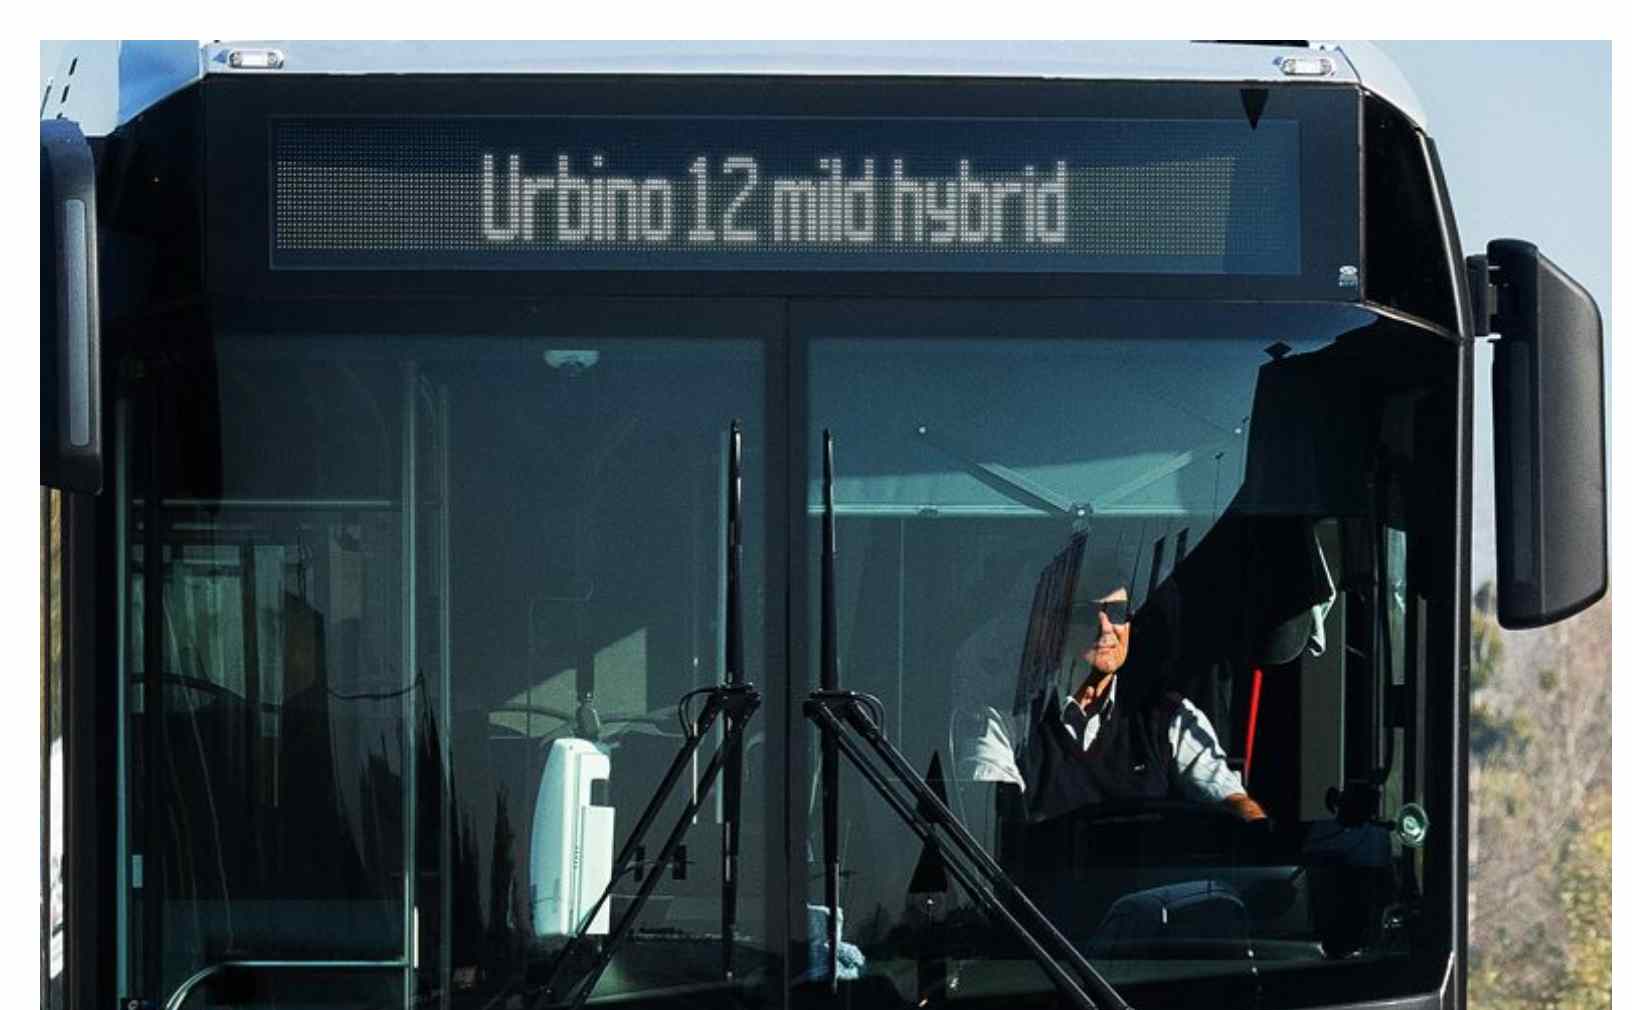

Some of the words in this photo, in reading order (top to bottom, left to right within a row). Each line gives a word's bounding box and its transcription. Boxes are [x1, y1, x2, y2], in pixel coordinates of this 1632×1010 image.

[483, 154, 671, 241] Urbino
[688, 156, 757, 241] 12
[773, 157, 874, 242] mild
[894, 158, 1065, 243] hybrid
